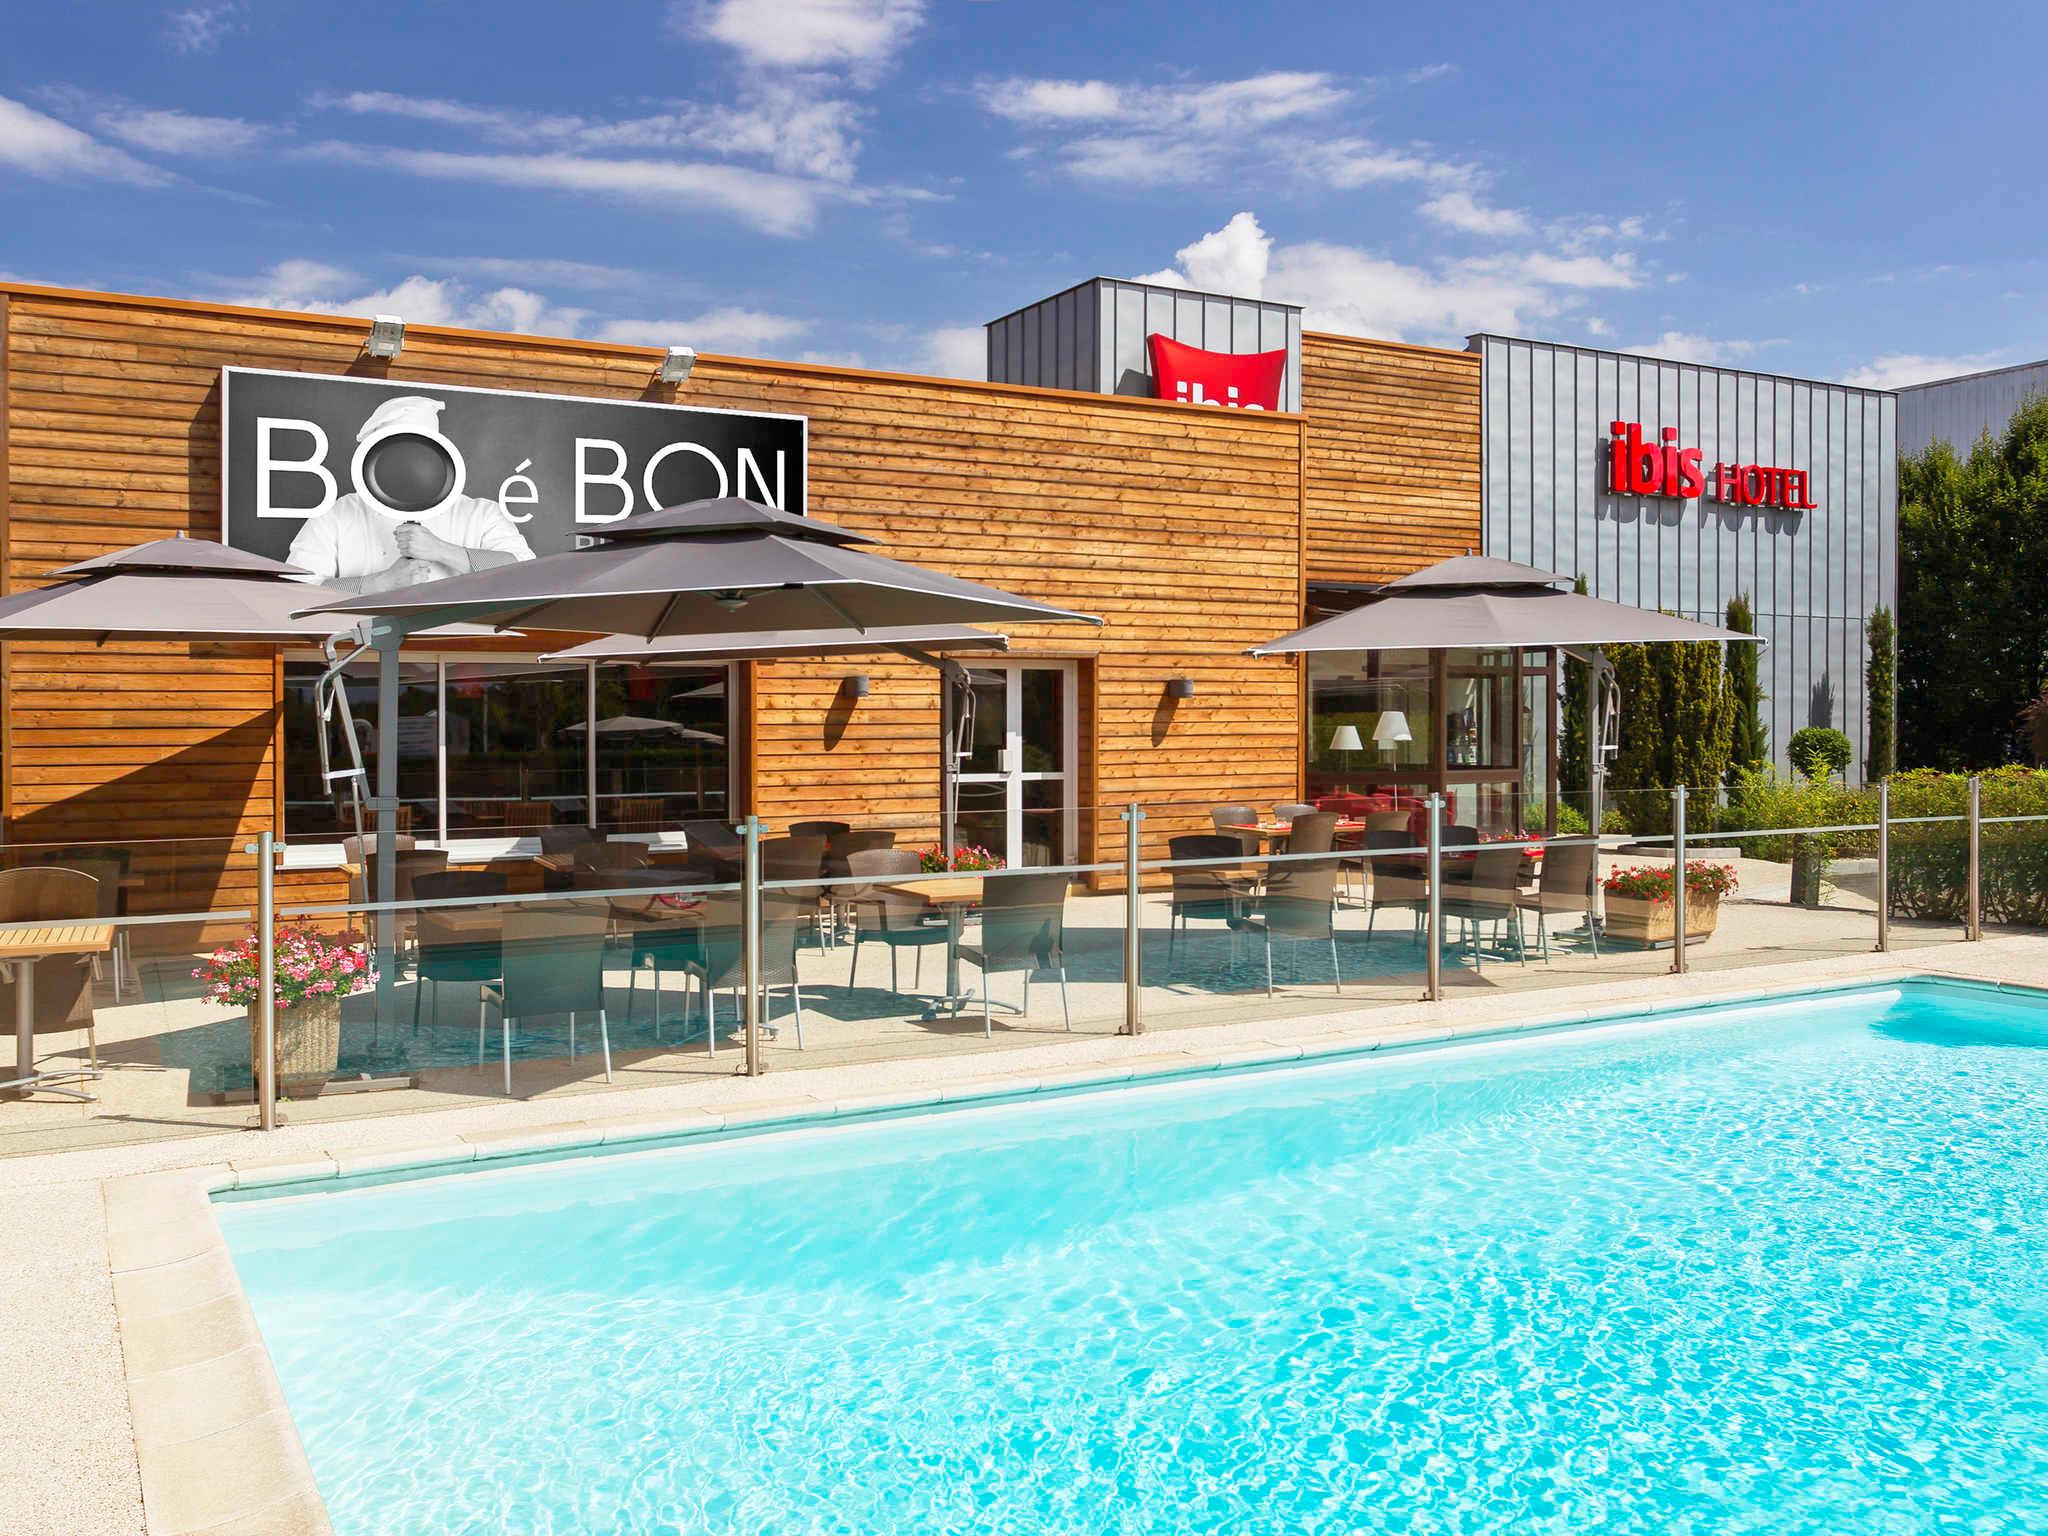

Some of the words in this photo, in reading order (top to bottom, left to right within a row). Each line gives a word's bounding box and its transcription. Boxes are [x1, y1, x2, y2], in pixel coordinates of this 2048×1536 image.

[257, 416, 466, 521] BO
[498, 457, 539, 524] é
[575, 437, 786, 524] BON
[1609, 420, 1706, 498] ibis
[1715, 462, 1818, 509] HOTEL
